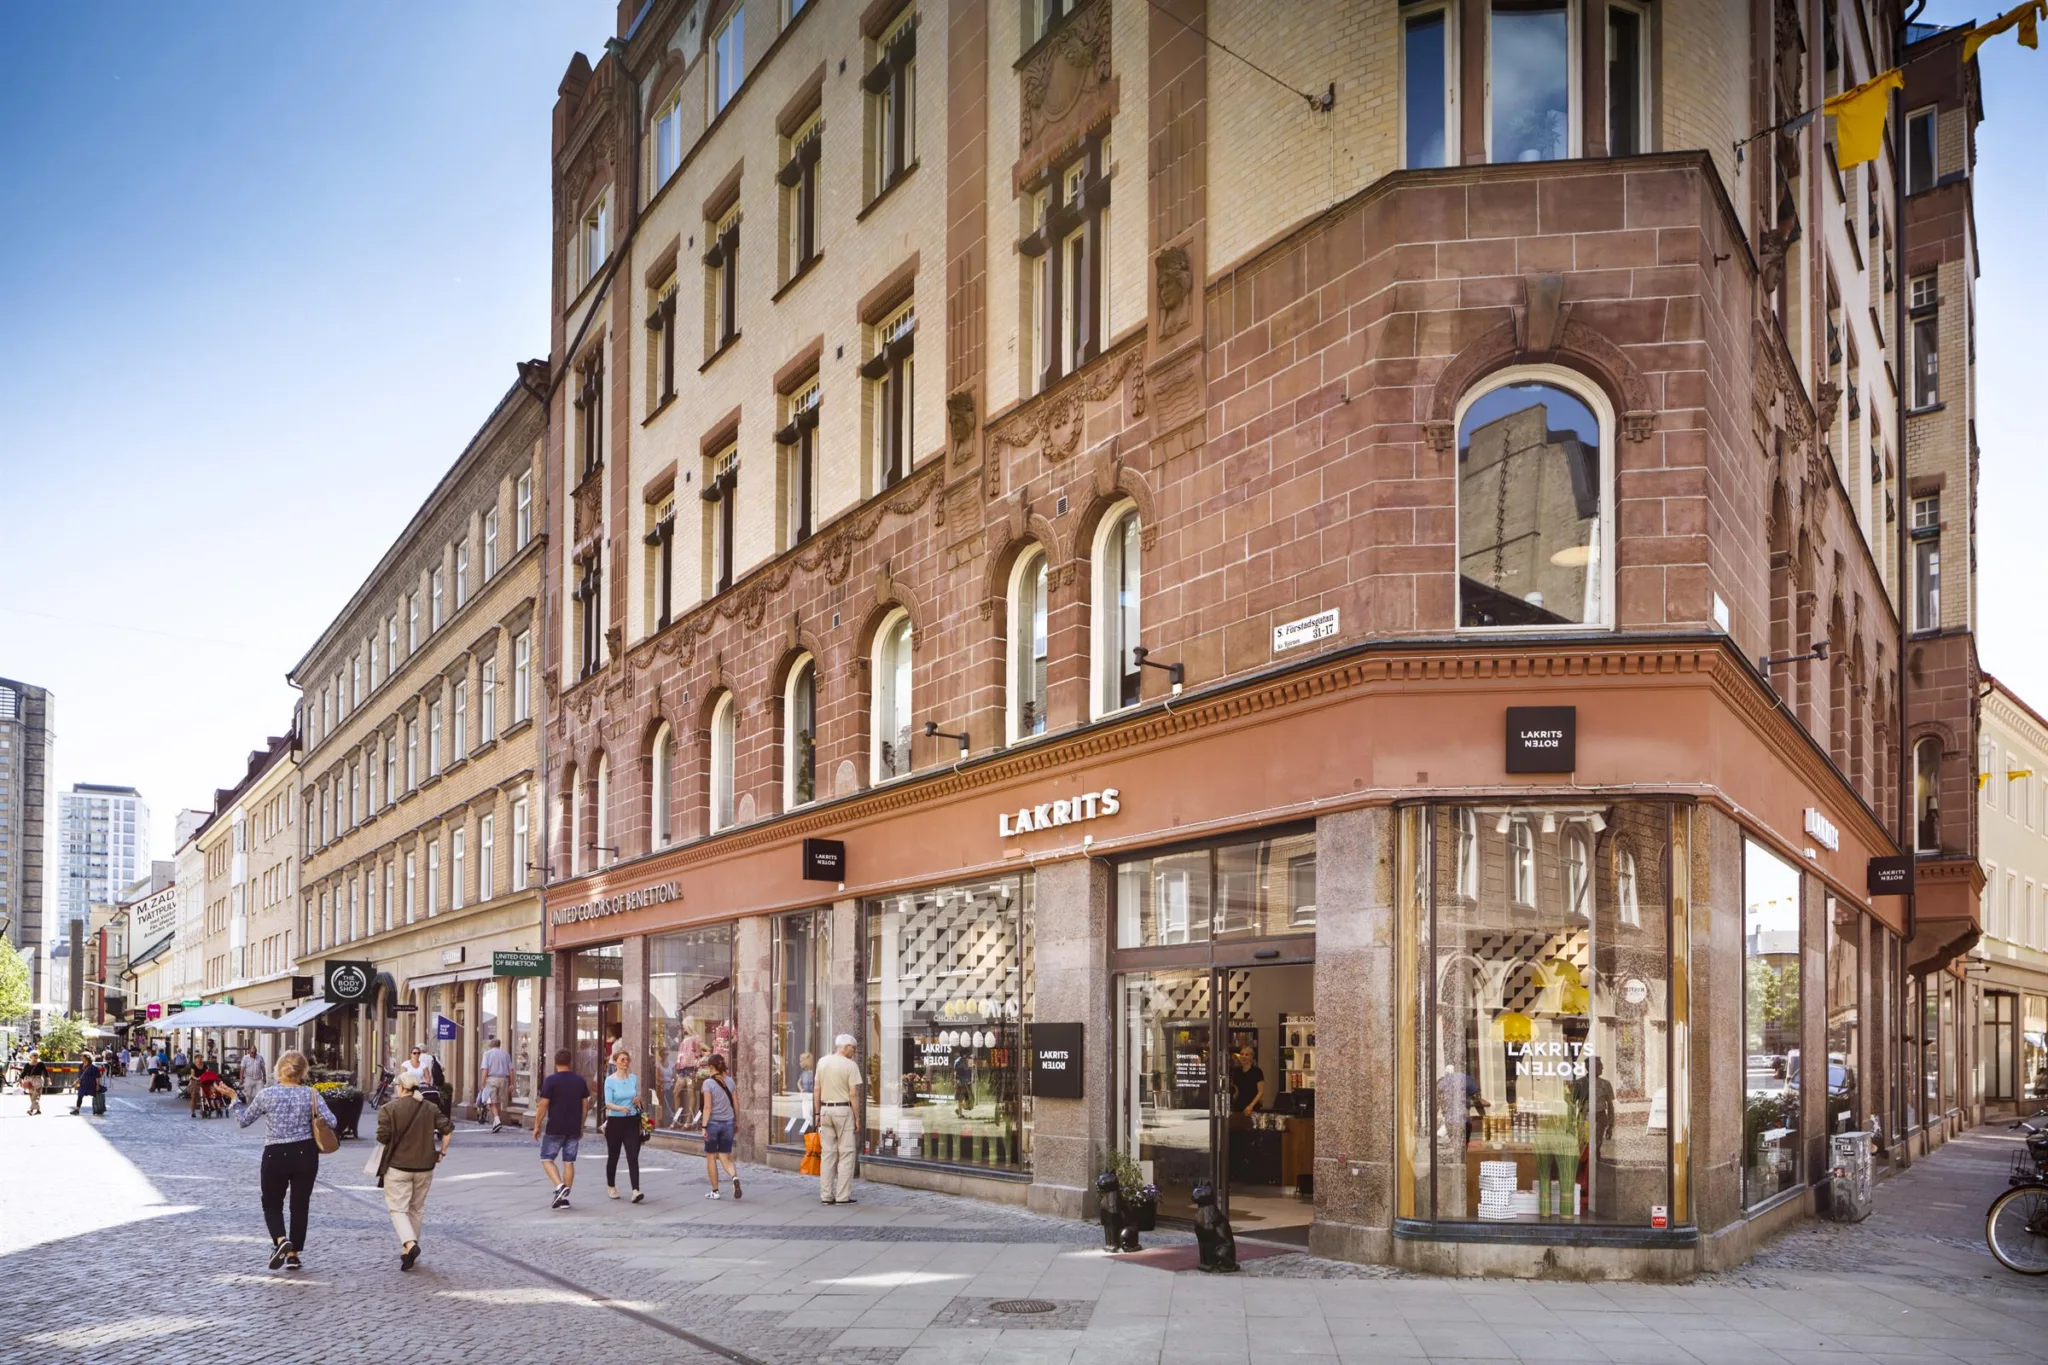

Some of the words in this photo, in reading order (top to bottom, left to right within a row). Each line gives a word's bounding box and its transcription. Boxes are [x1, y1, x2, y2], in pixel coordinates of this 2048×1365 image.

[1286, 614, 1334, 635] Förstadsgatan
[1312, 623, 1334, 639] 31-17
[1521, 730, 1563, 739] LAKRITS
[1524, 740, 1559, 748] ROTEN
[1000, 788, 1120, 838] LAKRITS
[549, 906, 577, 927] UNITED
[578, 898, 611, 921] COLORS
[612, 894, 625, 913] OF
[933, 1014, 969, 1023] CHOKLAD
[1300, 1015, 1315, 1023] ROO
[921, 1043, 952, 1053] LAKRITS
[1507, 1041, 1595, 1057] LAKRITS
[1040, 1051, 1069, 1059] LAKRITS
[923, 1056, 949, 1066] ROTEN
[1042, 1061, 1066, 1070] ROTEN
[1516, 1061, 1588, 1076] ROTEN
